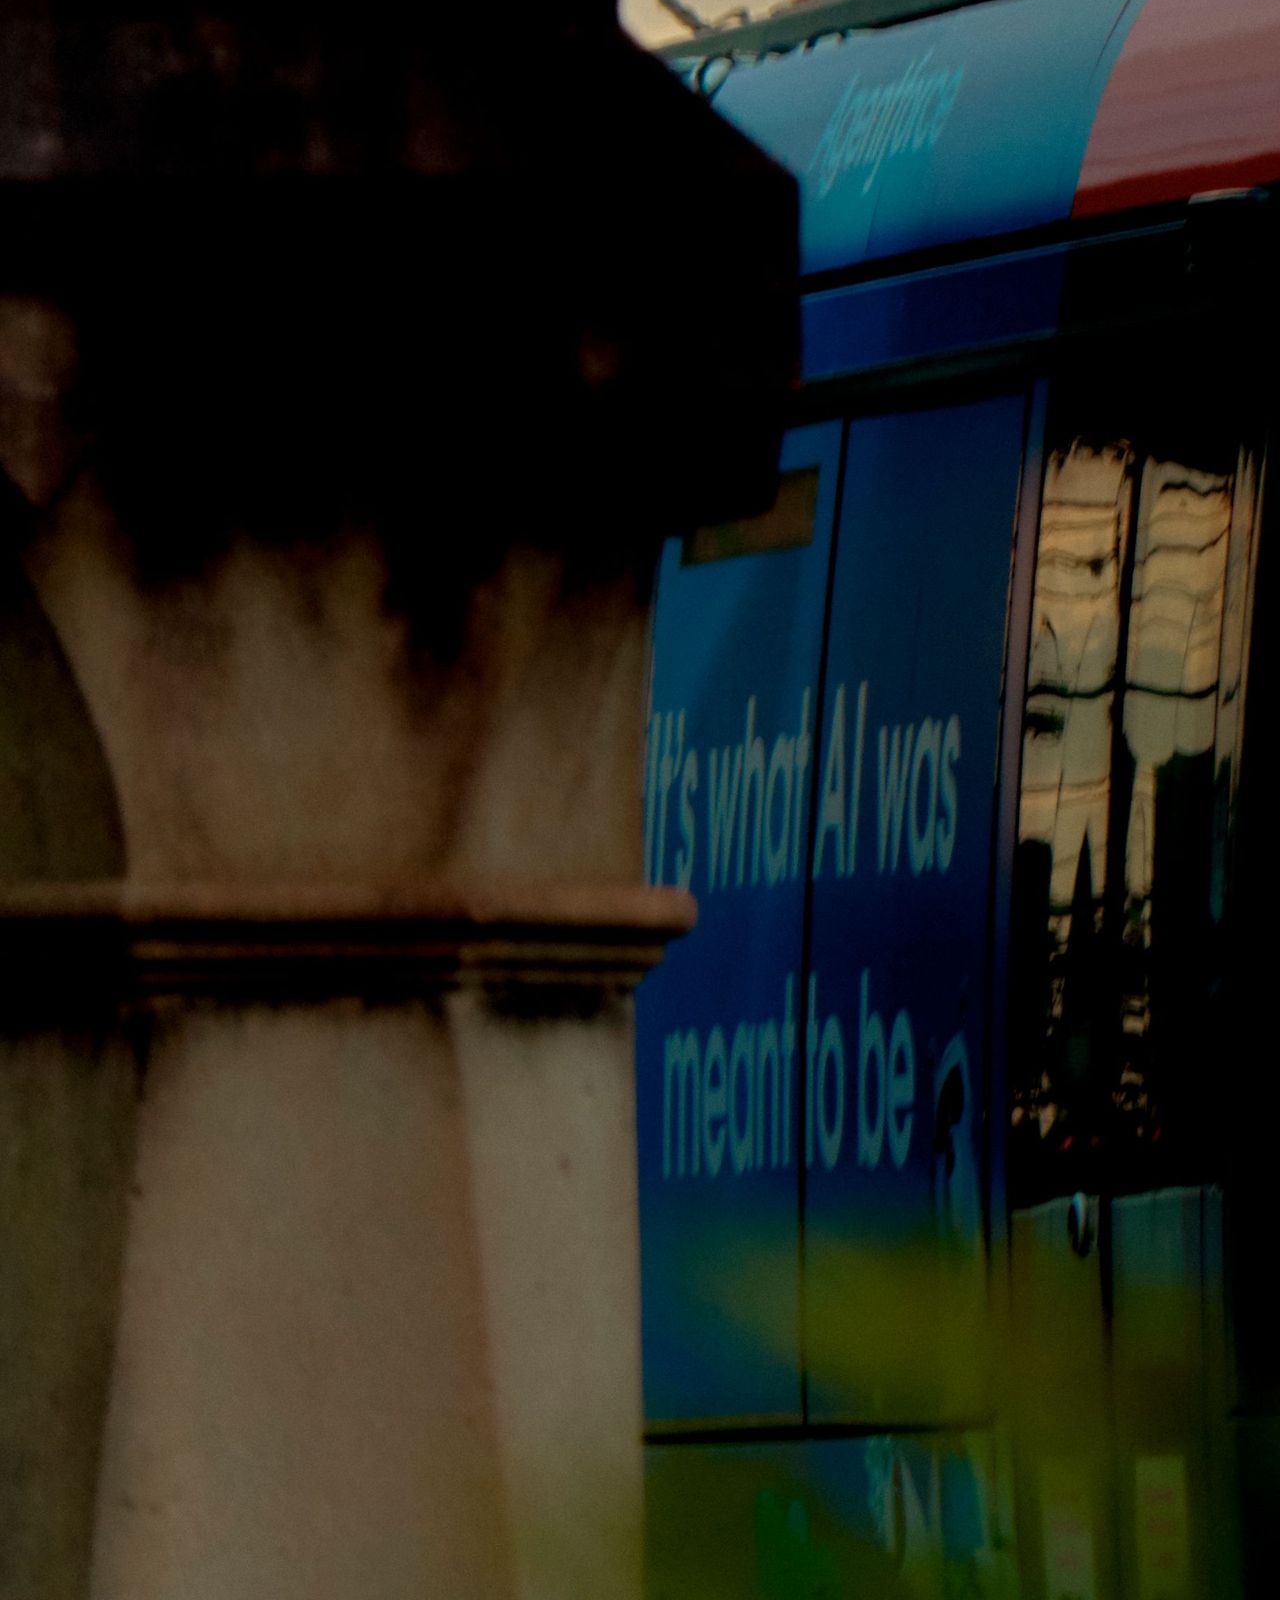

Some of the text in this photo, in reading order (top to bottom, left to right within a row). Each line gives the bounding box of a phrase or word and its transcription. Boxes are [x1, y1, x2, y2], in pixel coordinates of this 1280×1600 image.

[706, 686, 812, 894] what
[877, 712, 962, 880] was
[662, 967, 916, 1180] meant to be
